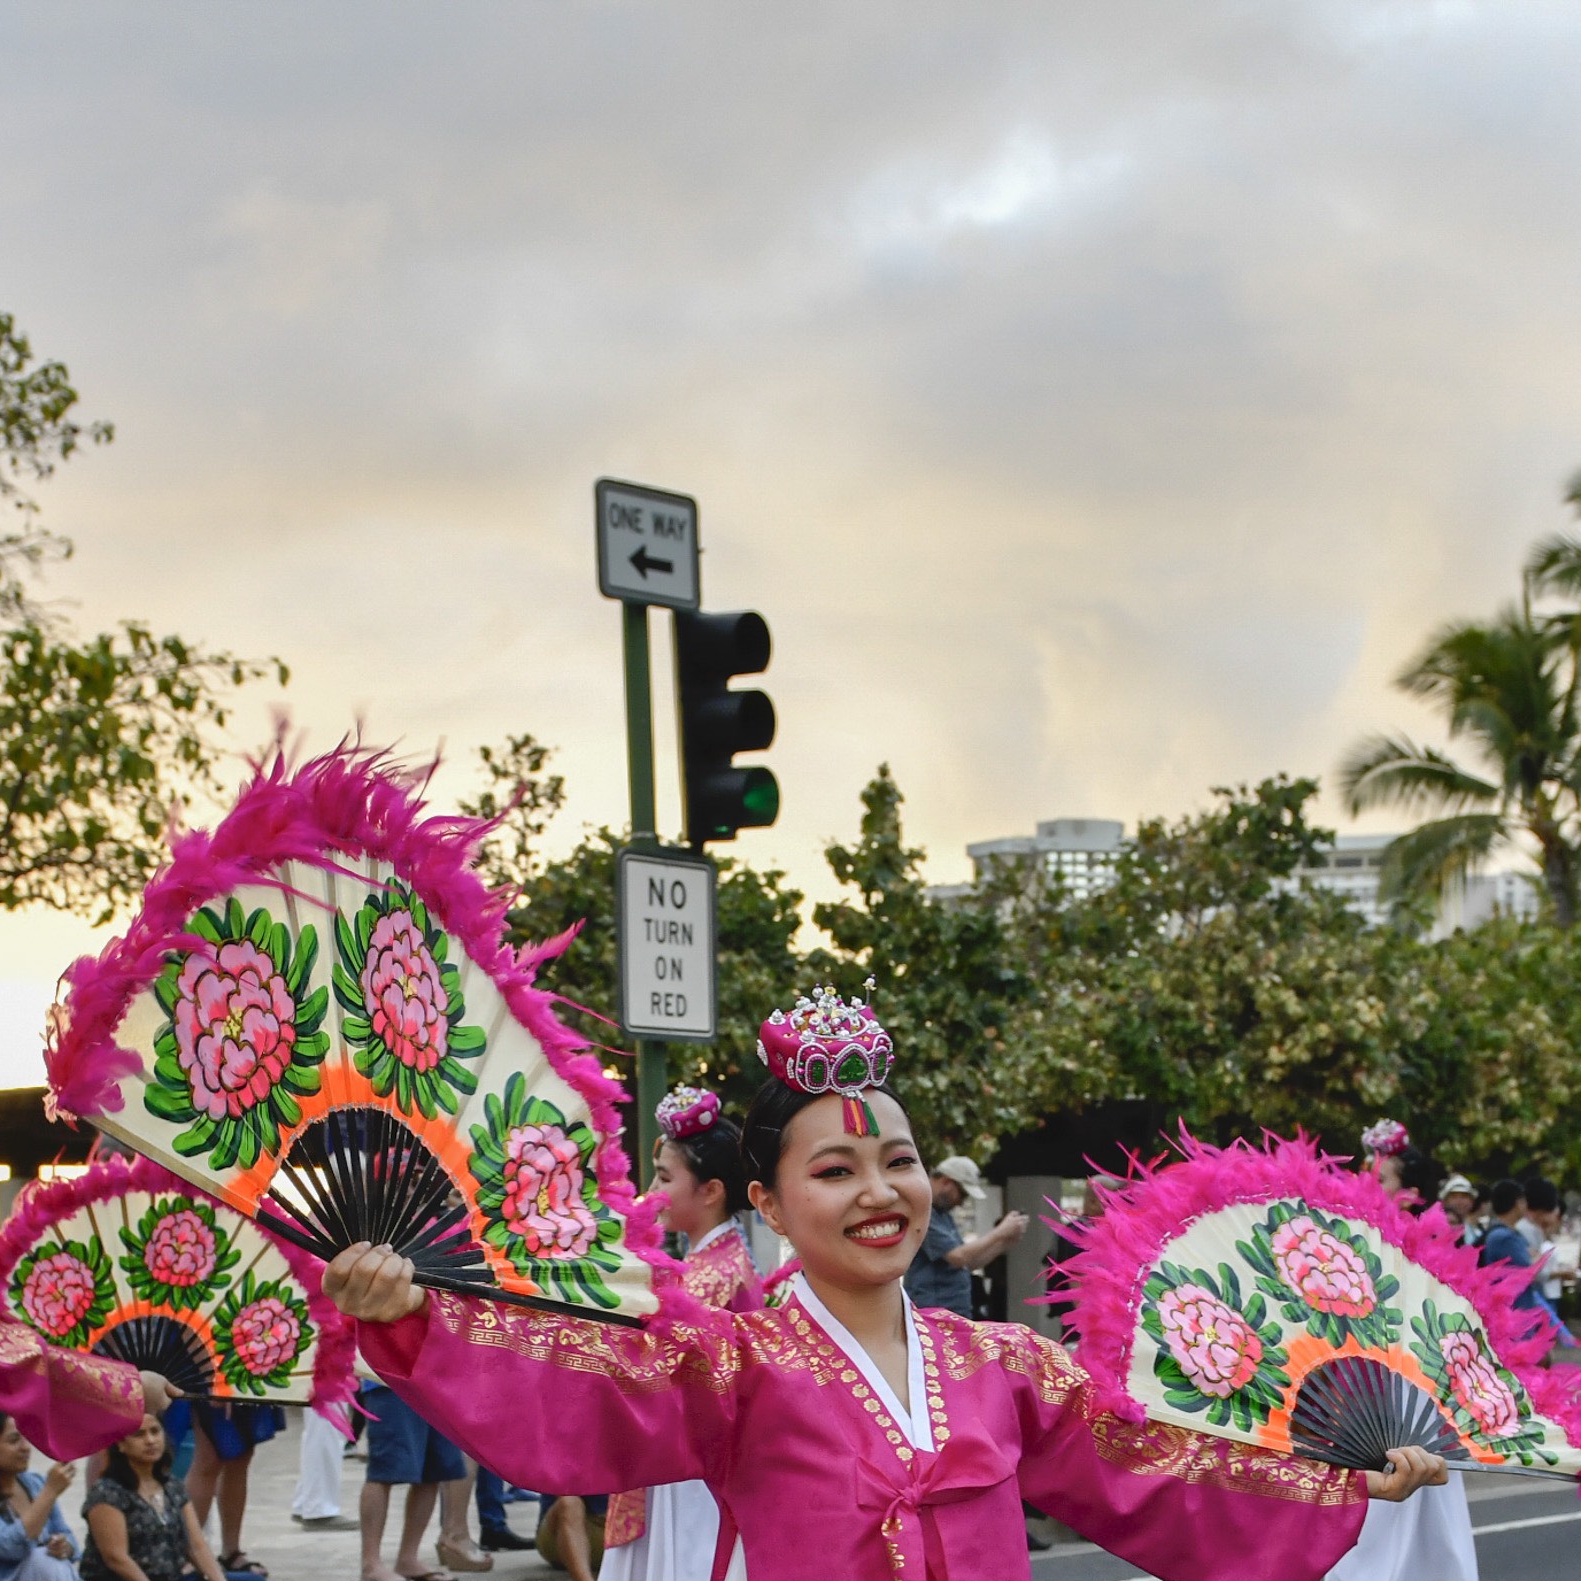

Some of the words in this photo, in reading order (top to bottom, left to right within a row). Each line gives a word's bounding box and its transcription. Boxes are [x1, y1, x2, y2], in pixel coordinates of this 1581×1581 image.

[609, 502, 644, 535] ONE
[651, 510, 688, 542] WAY
[648, 876, 687, 910] NO
[643, 917, 694, 946] TURN
[654, 955, 683, 982] ON
[650, 991, 688, 1018] RED
